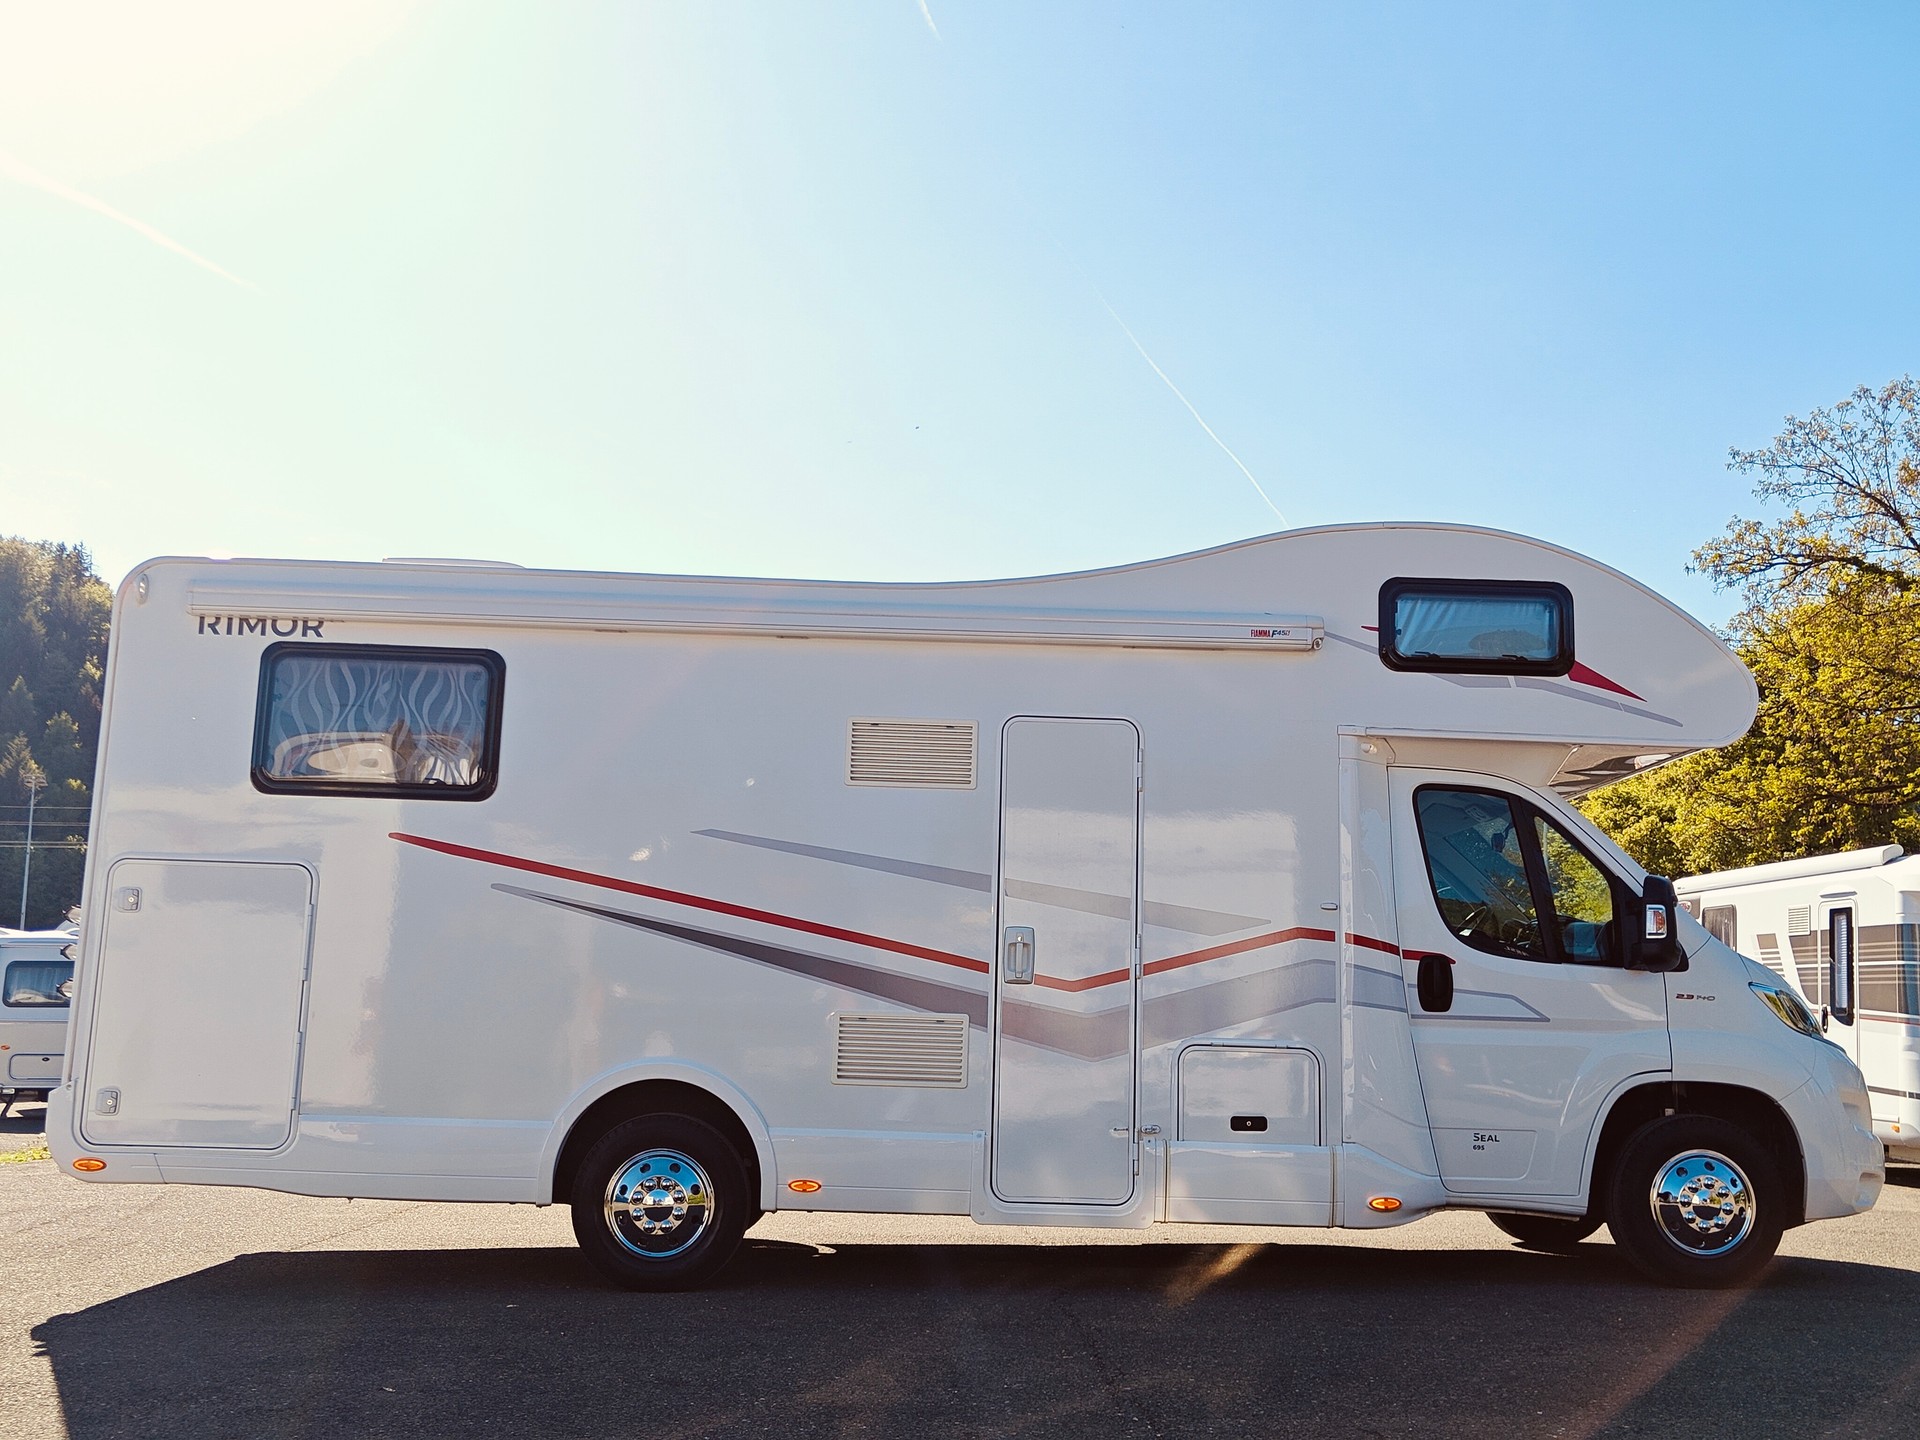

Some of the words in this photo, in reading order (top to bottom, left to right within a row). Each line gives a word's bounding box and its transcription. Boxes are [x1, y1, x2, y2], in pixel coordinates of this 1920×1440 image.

[198, 615, 325, 638] RIMOR
[1250, 629, 1271, 638] FIAMMA
[1472, 1132, 1500, 1142] SEAL
